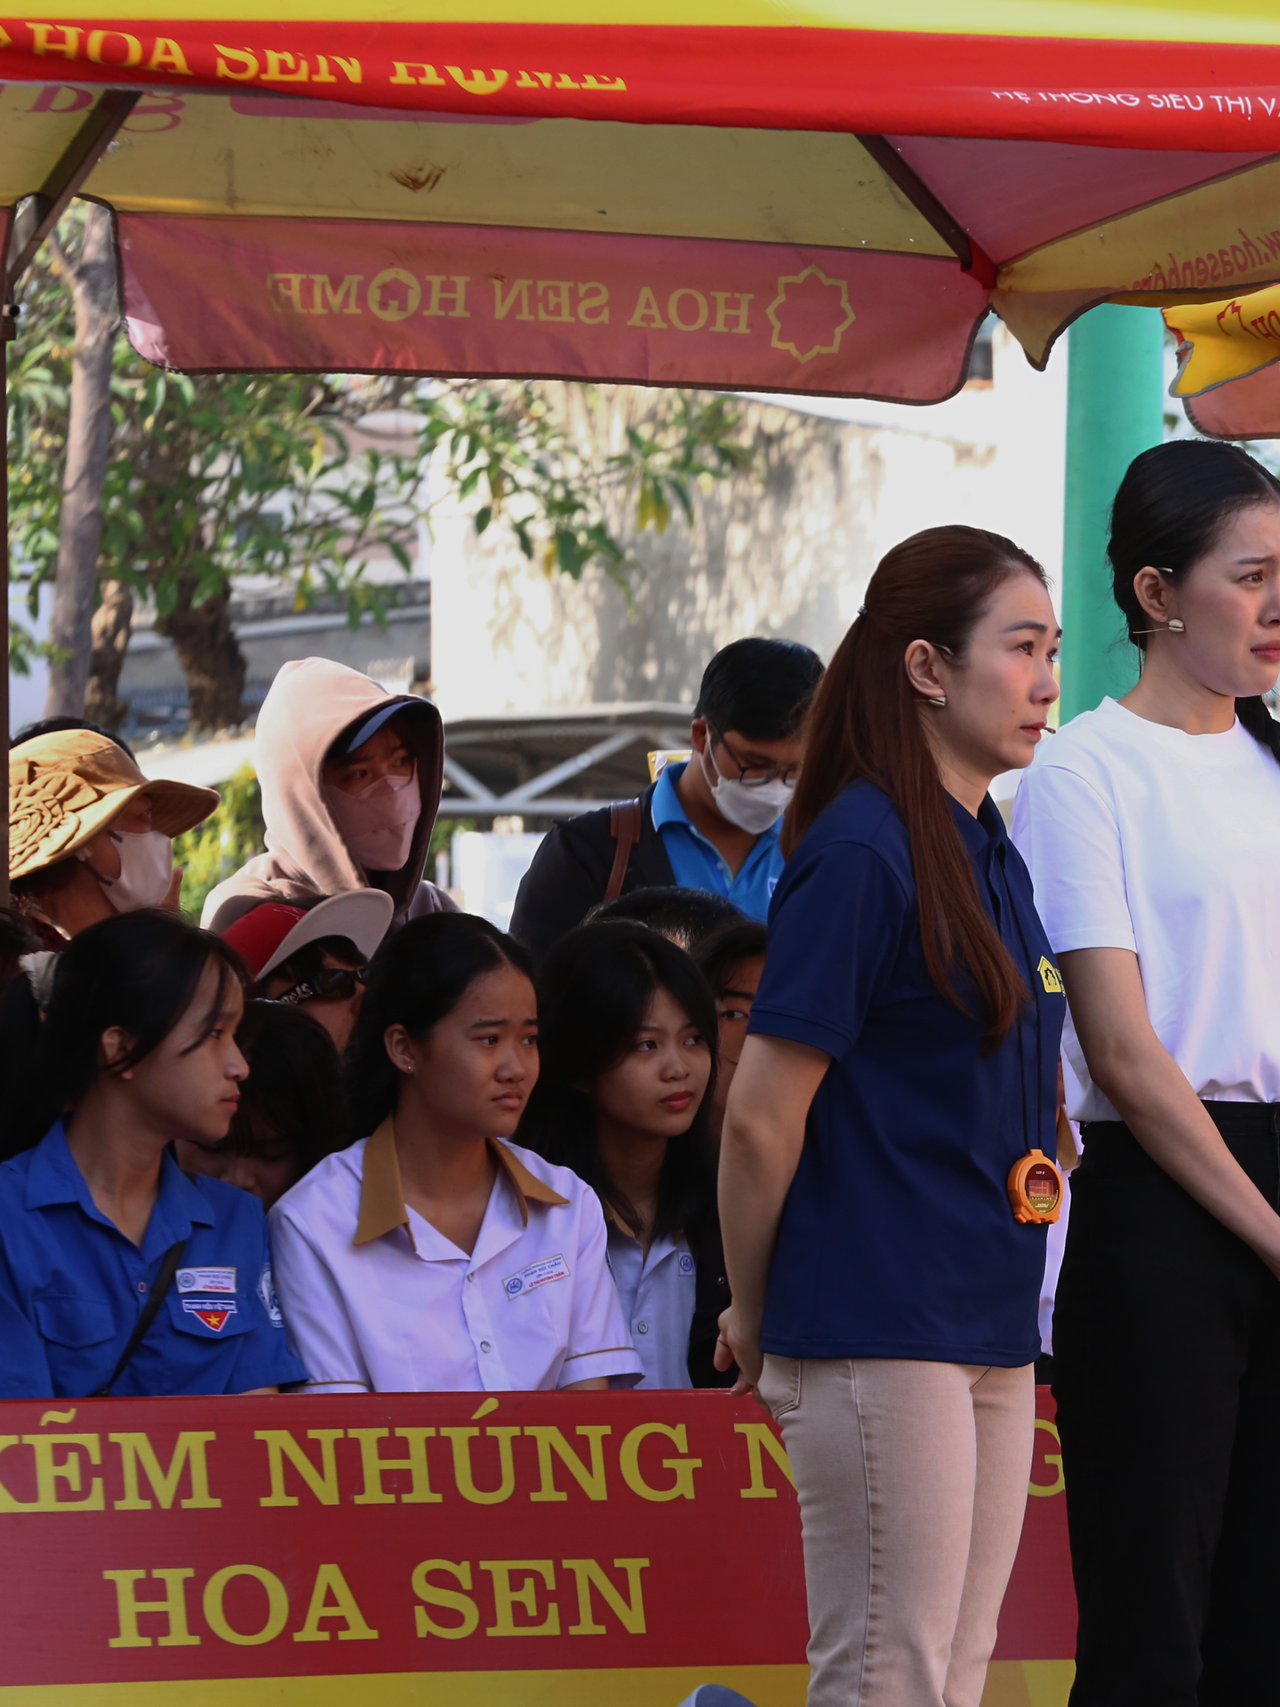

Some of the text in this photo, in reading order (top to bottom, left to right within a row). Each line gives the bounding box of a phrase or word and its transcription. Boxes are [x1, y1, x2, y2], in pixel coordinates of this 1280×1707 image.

[24, 21, 194, 76] HOA
[1209, 94, 1252, 121] THỊ
[254, 1397, 704, 1508] NHÚNG
[102, 1557, 651, 1649] HOA SEN
